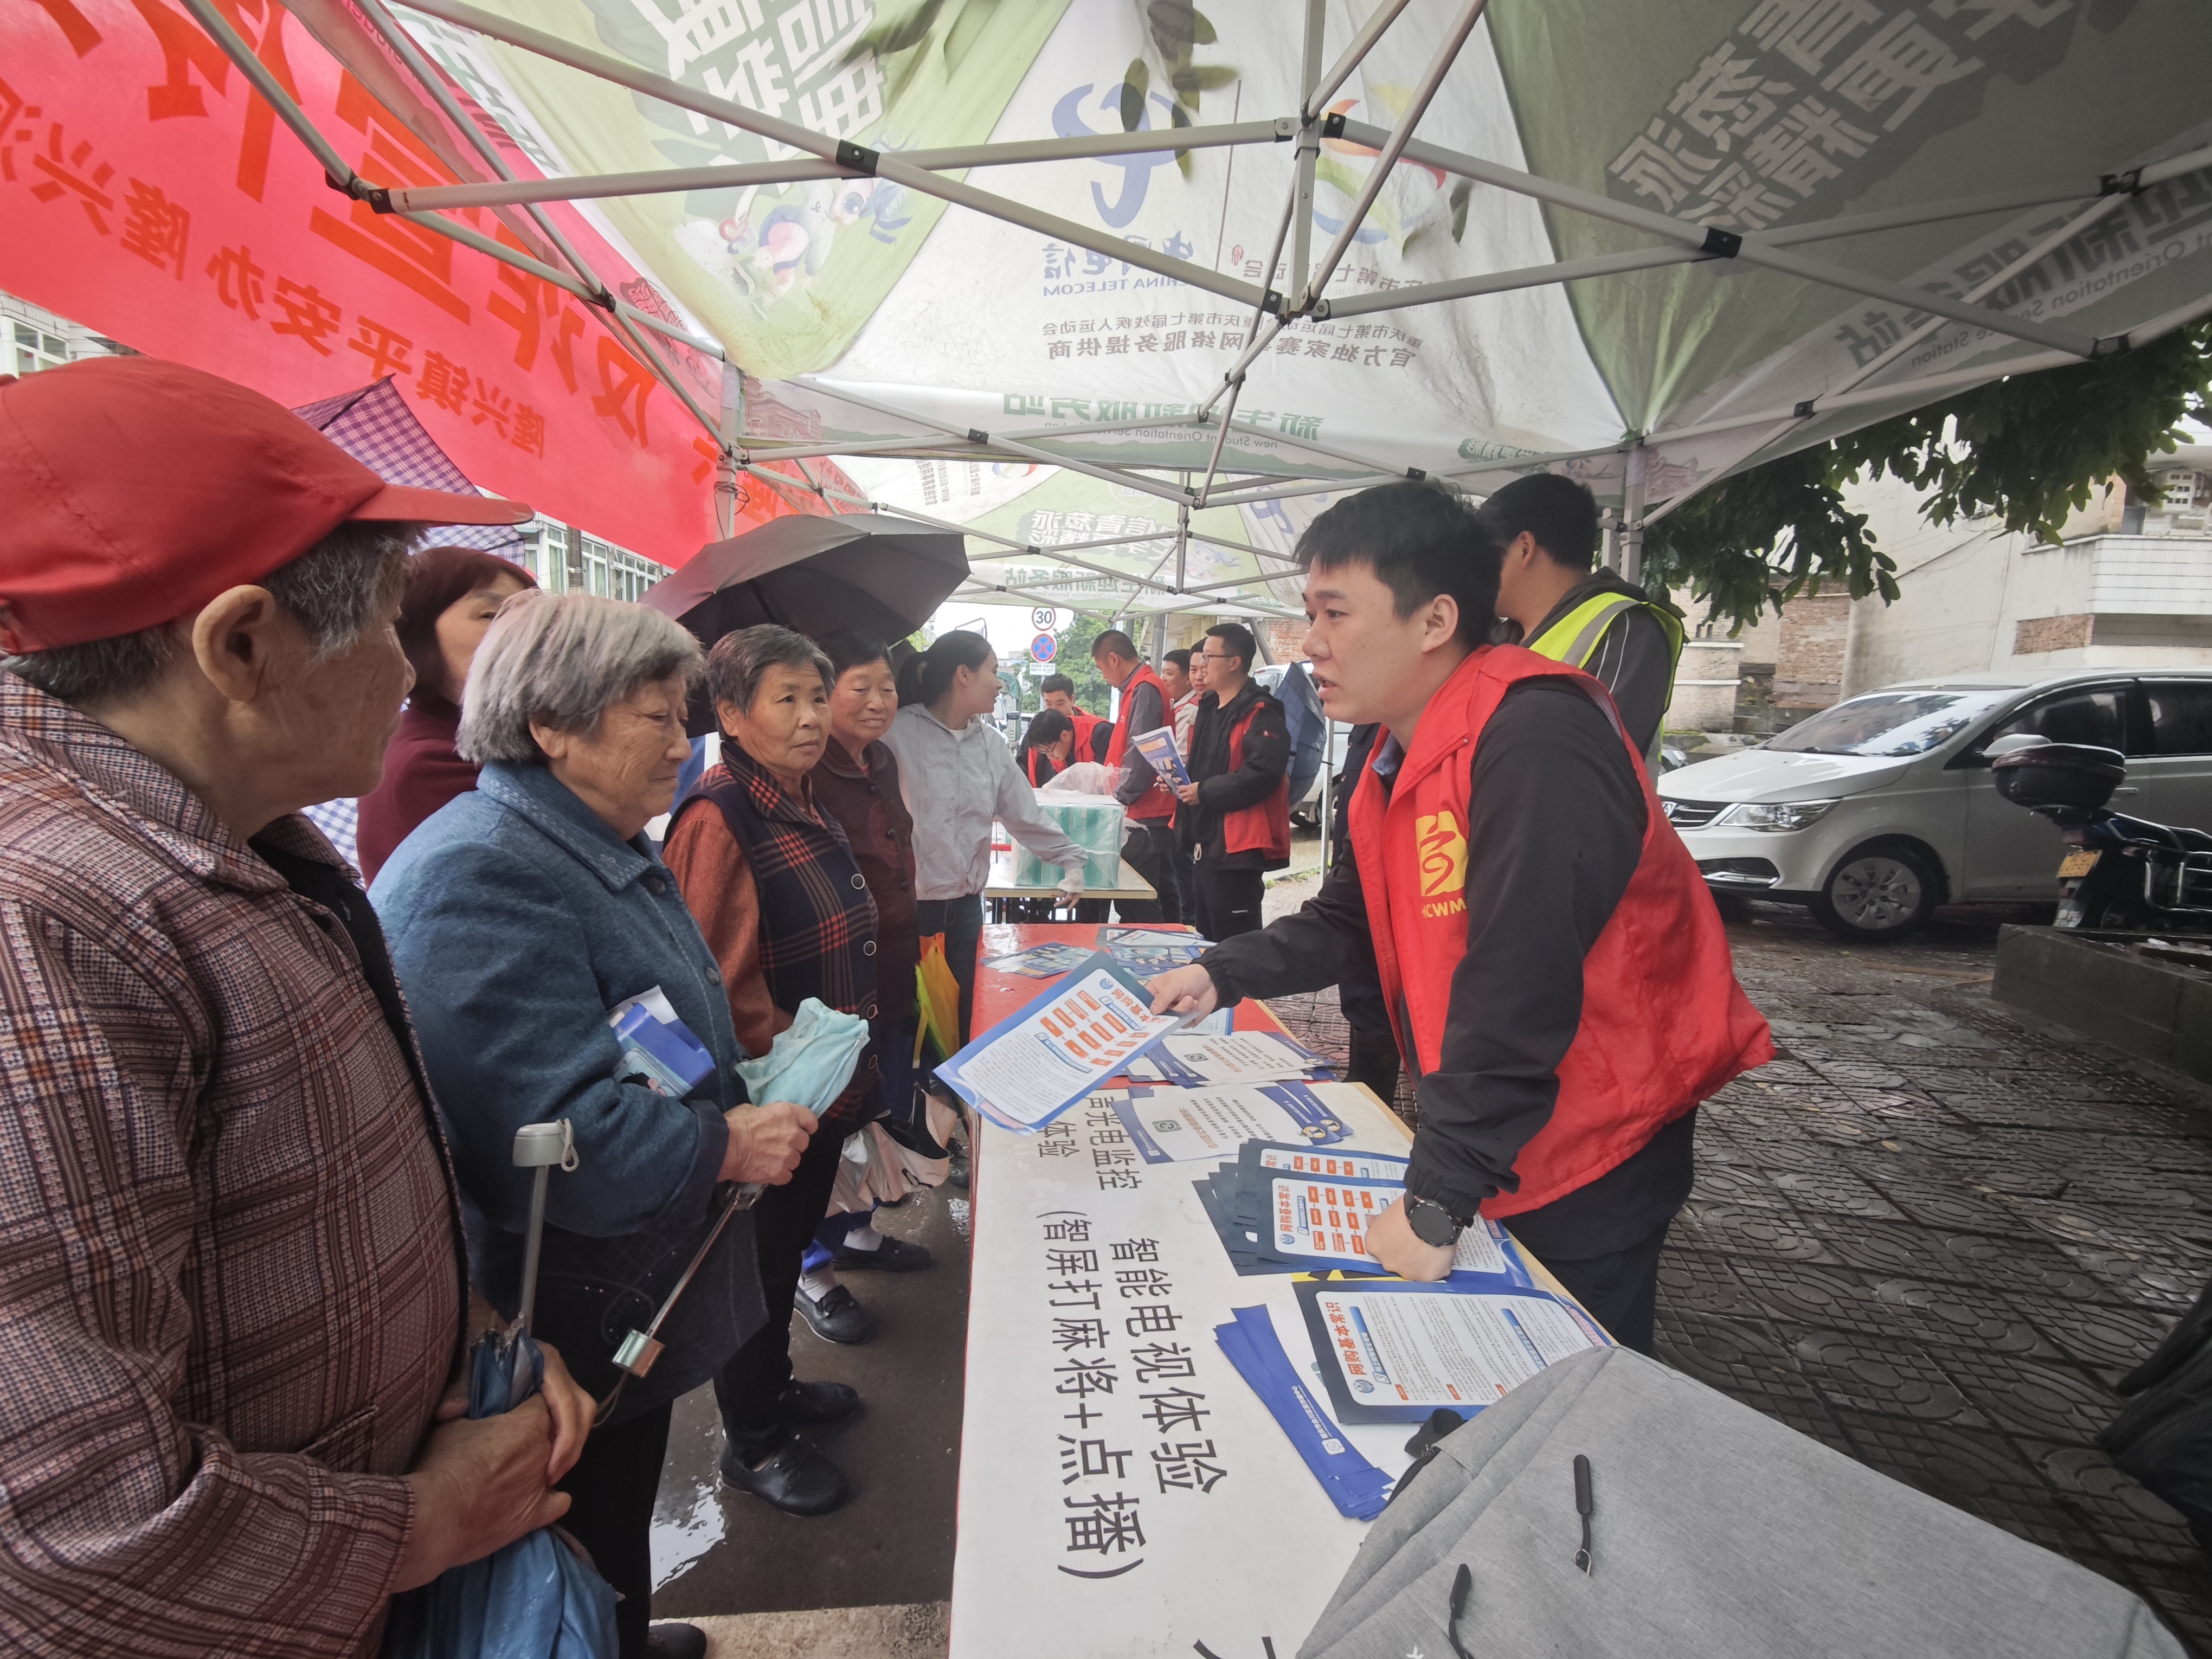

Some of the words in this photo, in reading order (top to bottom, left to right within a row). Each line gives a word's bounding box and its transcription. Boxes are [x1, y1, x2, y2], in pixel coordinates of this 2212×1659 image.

[1036, 610, 1052, 624] 30
[1036, 1120, 1081, 1159] 体验
[1278, 1184, 1291, 1233] 网购基本常识
[1324, 1301, 1368, 1376] 网购基本常识
[1109, 1237, 1228, 1495] 智能电视体验
